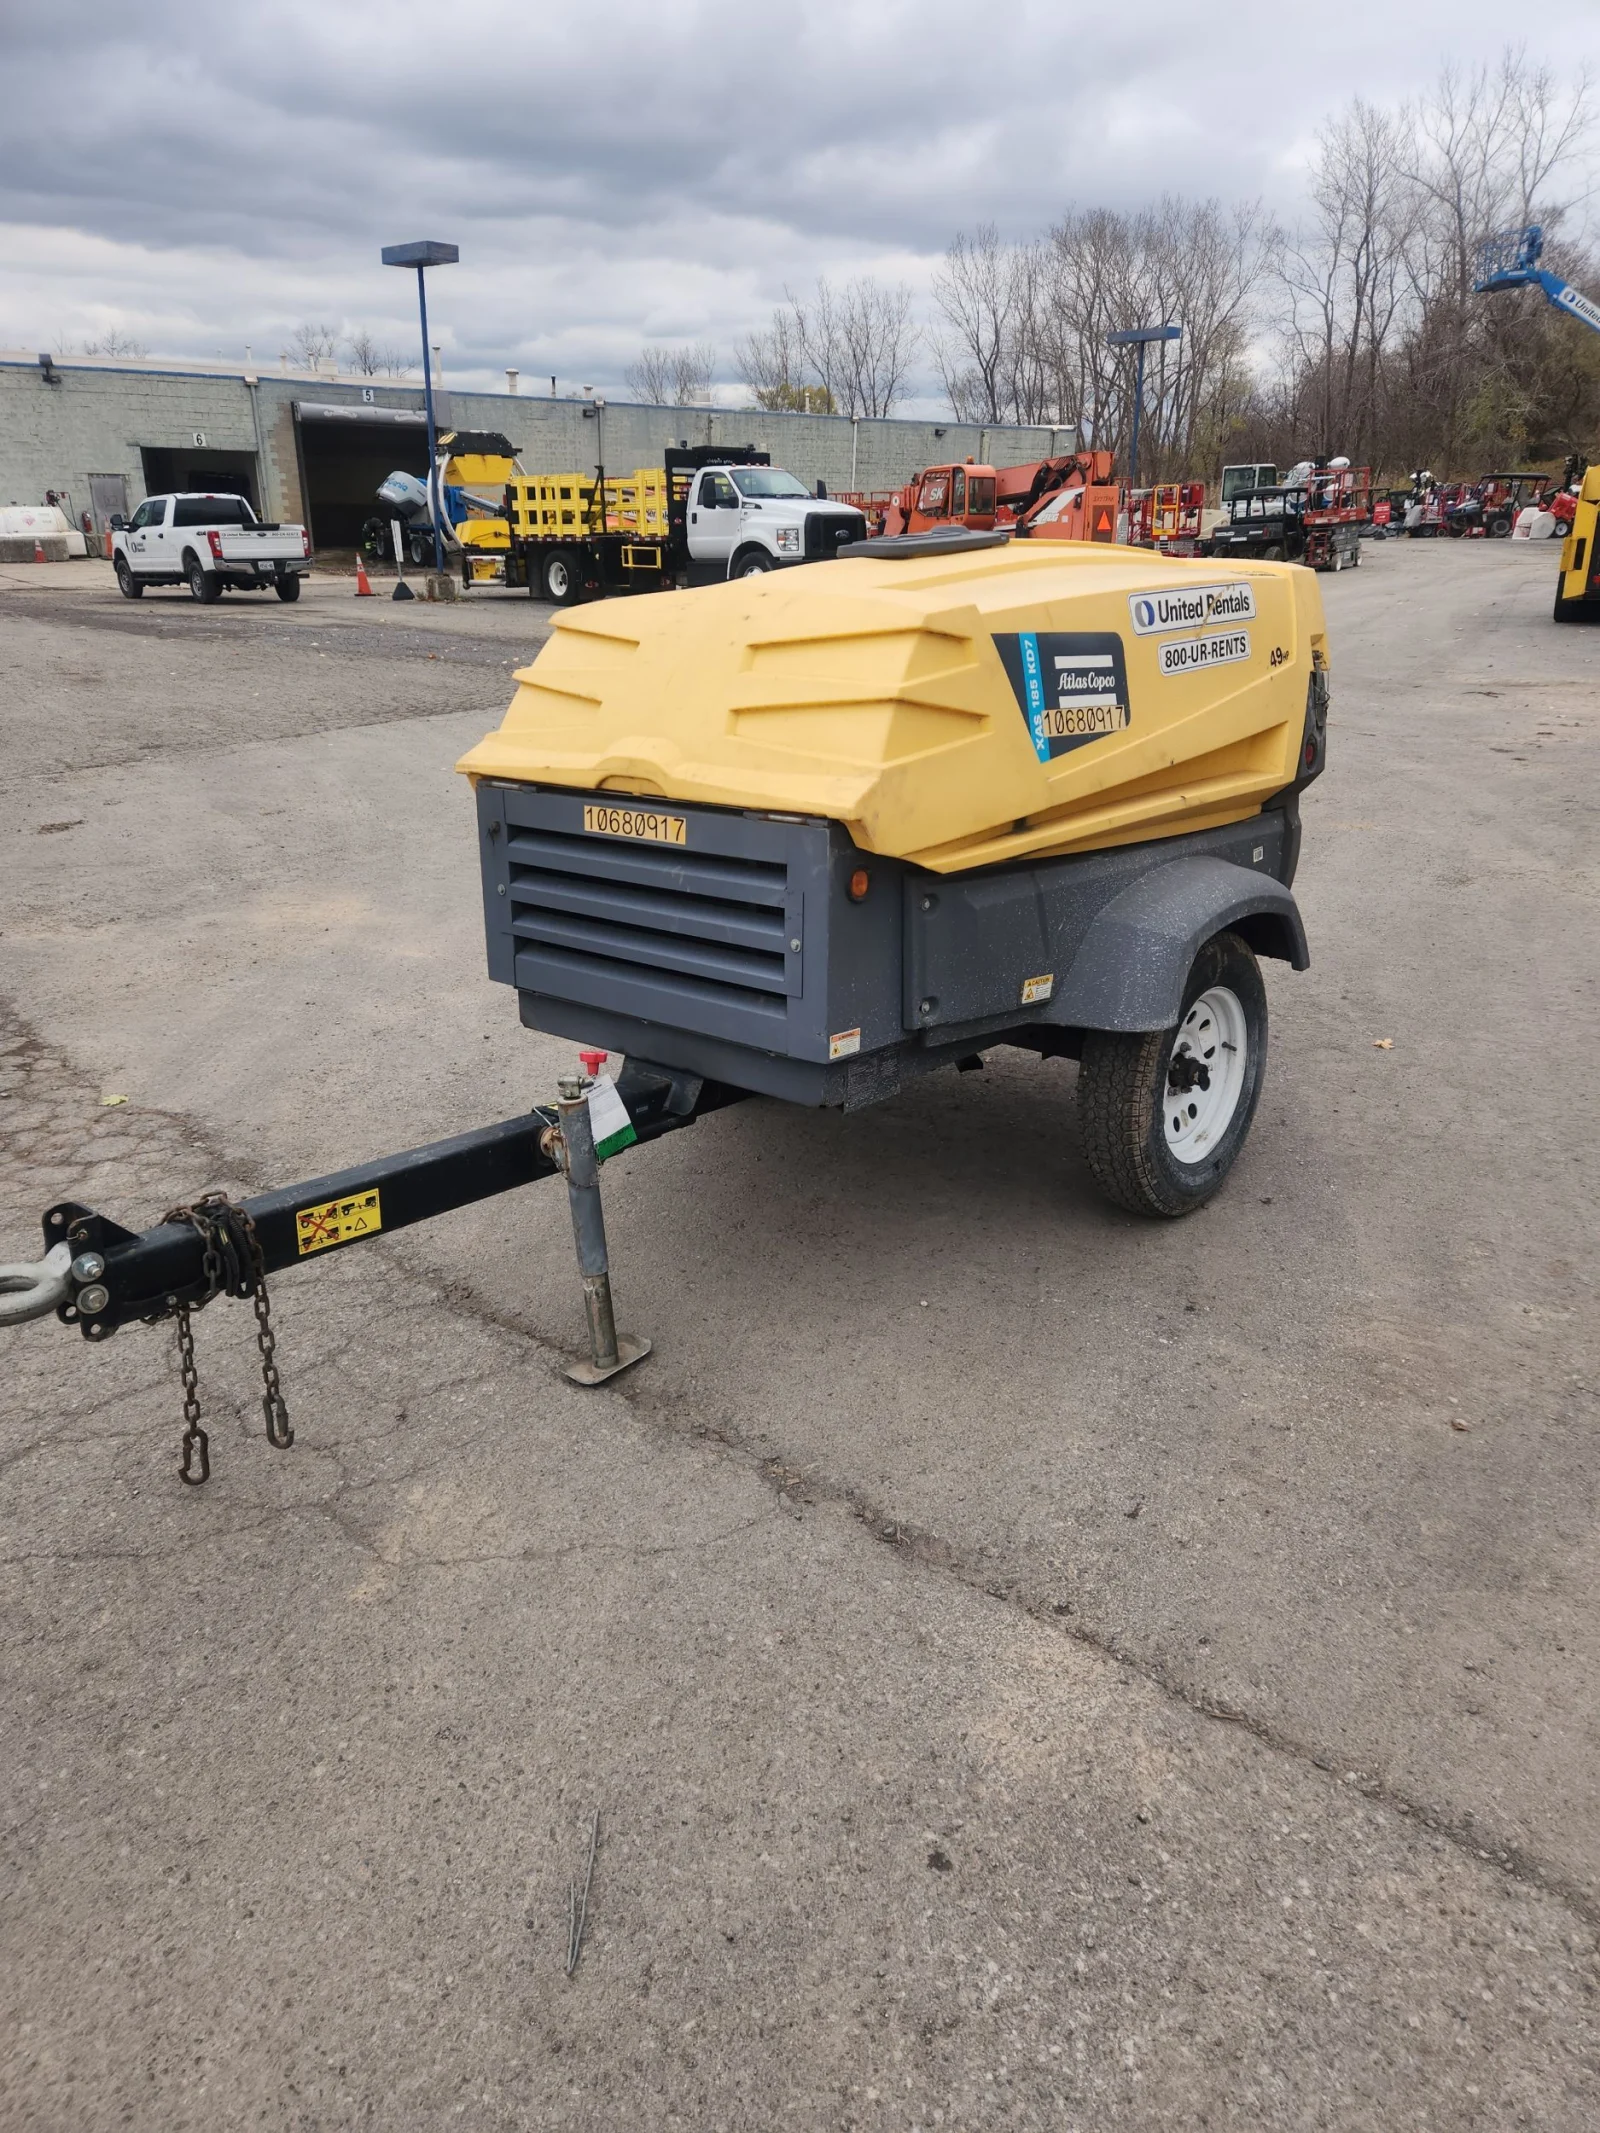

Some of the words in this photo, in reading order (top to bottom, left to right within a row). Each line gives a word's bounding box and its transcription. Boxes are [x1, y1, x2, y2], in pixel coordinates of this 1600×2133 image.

[365, 390, 371, 401] 5
[196, 433, 203, 446] 6
[1157, 595, 1204, 624] United
[1205, 590, 1250, 617] Rentals
[1024, 639, 1037, 674] KD7
[1165, 636, 1246, 669] 800-UR-RENTS
[1029, 679, 1041, 708] 185
[1057, 672, 1088, 690] Atlas
[1087, 671, 1116, 692] Copco
[1033, 713, 1046, 750] XAS
[1044, 705, 1124, 735] 10680917
[586, 806, 685, 842] 10680917
